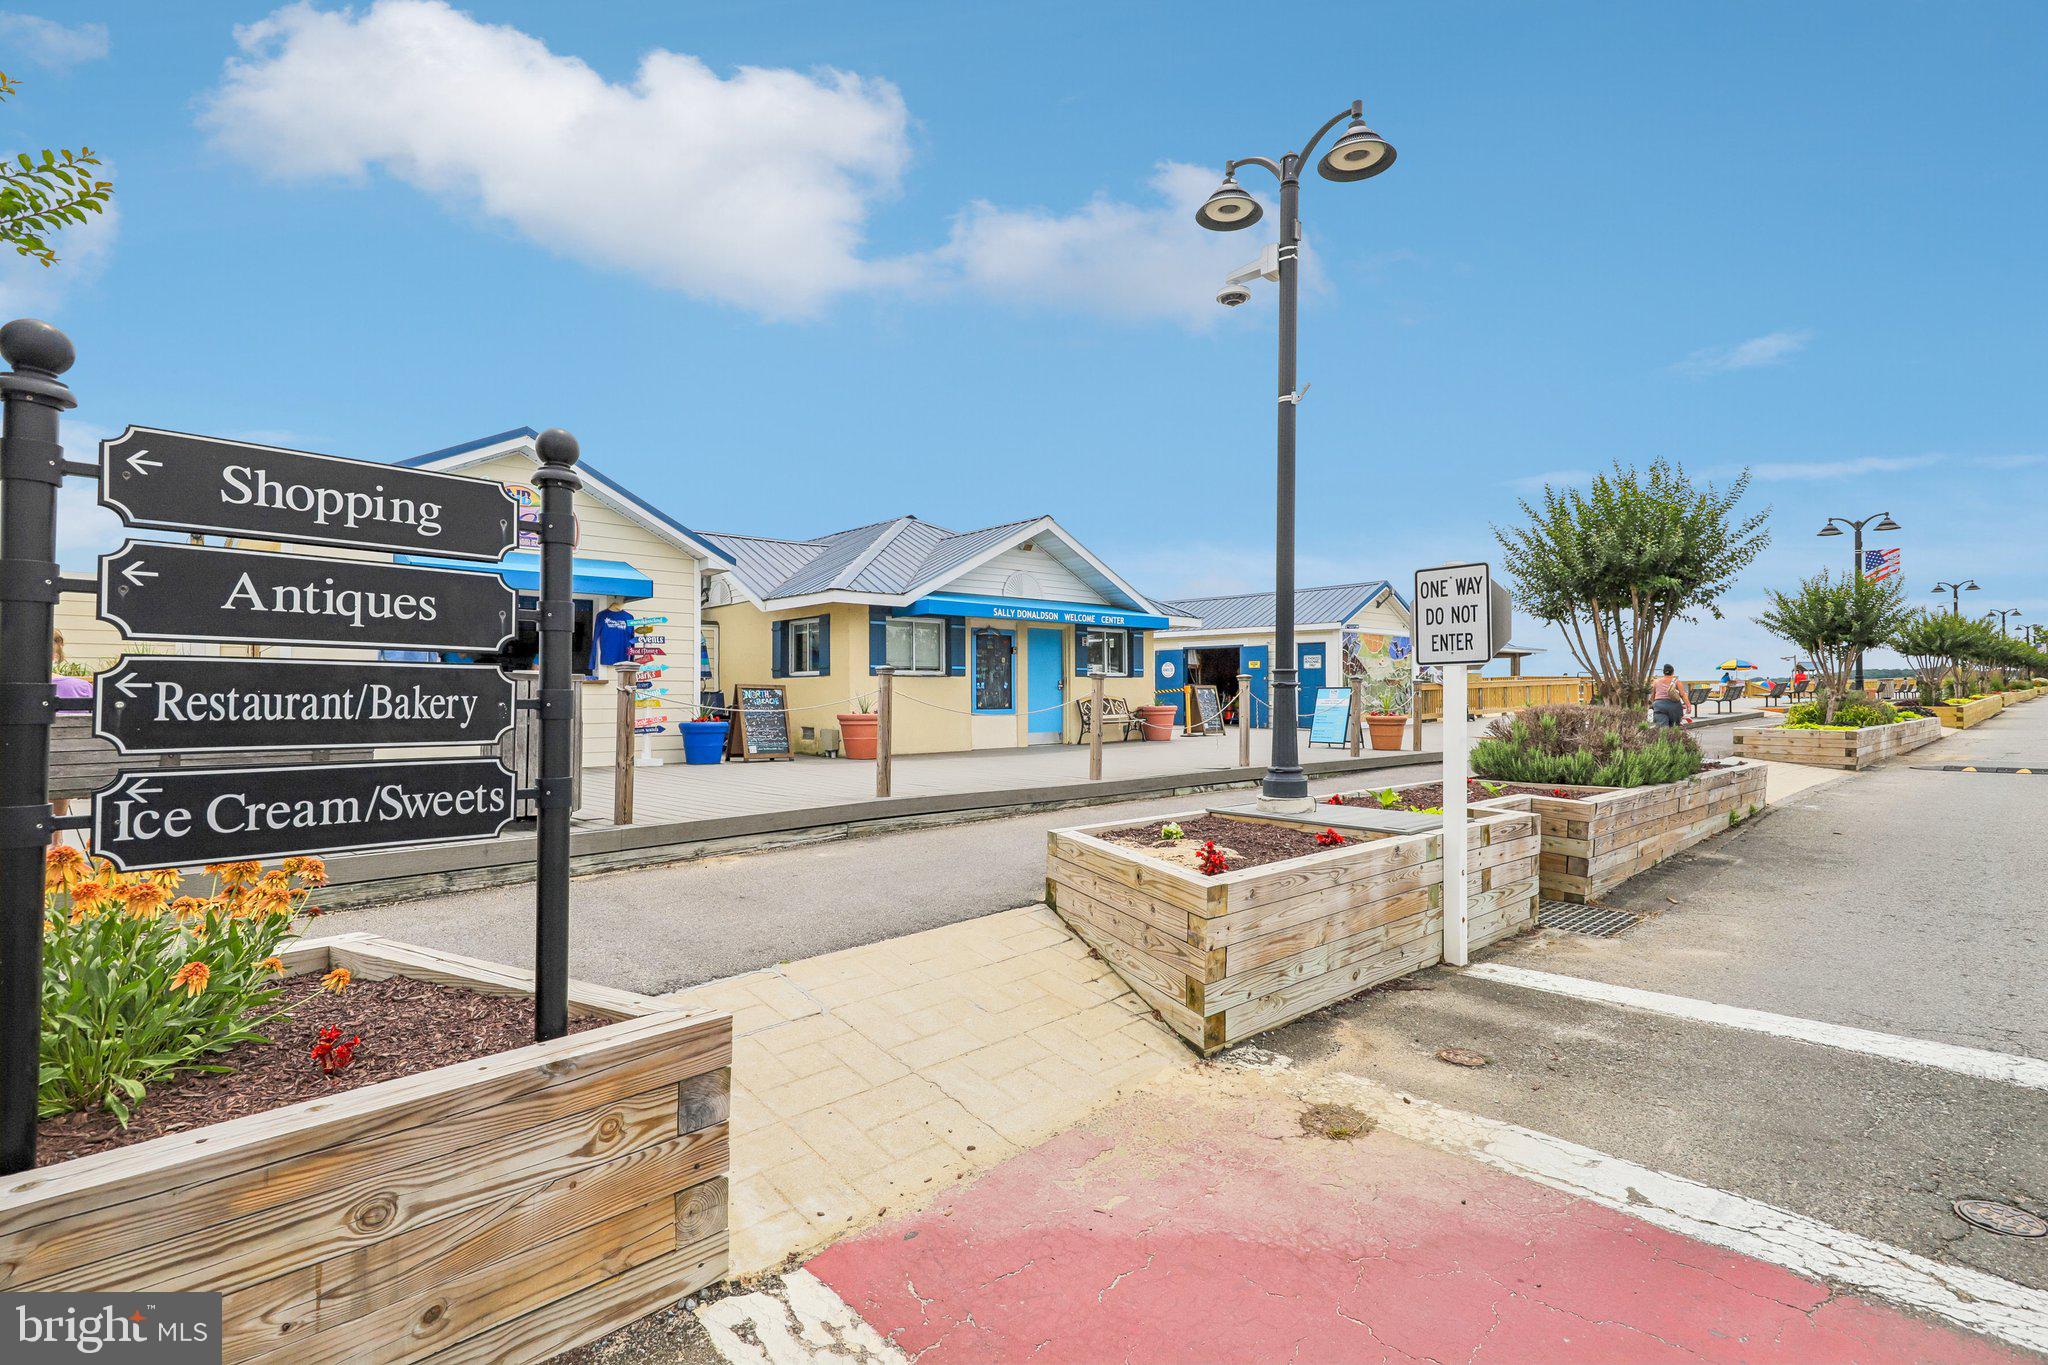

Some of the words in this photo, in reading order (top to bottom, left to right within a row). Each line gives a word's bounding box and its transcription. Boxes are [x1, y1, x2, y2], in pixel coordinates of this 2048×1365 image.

[220, 465, 442, 537] Shopping
[221, 571, 437, 627] Antiques
[1420, 580, 1449, 599] ONE
[1456, 575, 1483, 595] WAY
[993, 607, 1015, 618] SALLY
[1017, 609, 1059, 620] DONALDSON
[1064, 613, 1095, 623] WELCOME
[1101, 615, 1125, 625] CENTER
[1425, 607, 1444, 625] DO
[1451, 604, 1478, 623] NOT
[637, 635, 664, 644] events
[1431, 633, 1473, 652] ENTER
[154, 681, 478, 728] Restaurant/Bakery
[113, 800, 192, 842] Ice
[207, 784, 505, 833] Cream/Sweets
